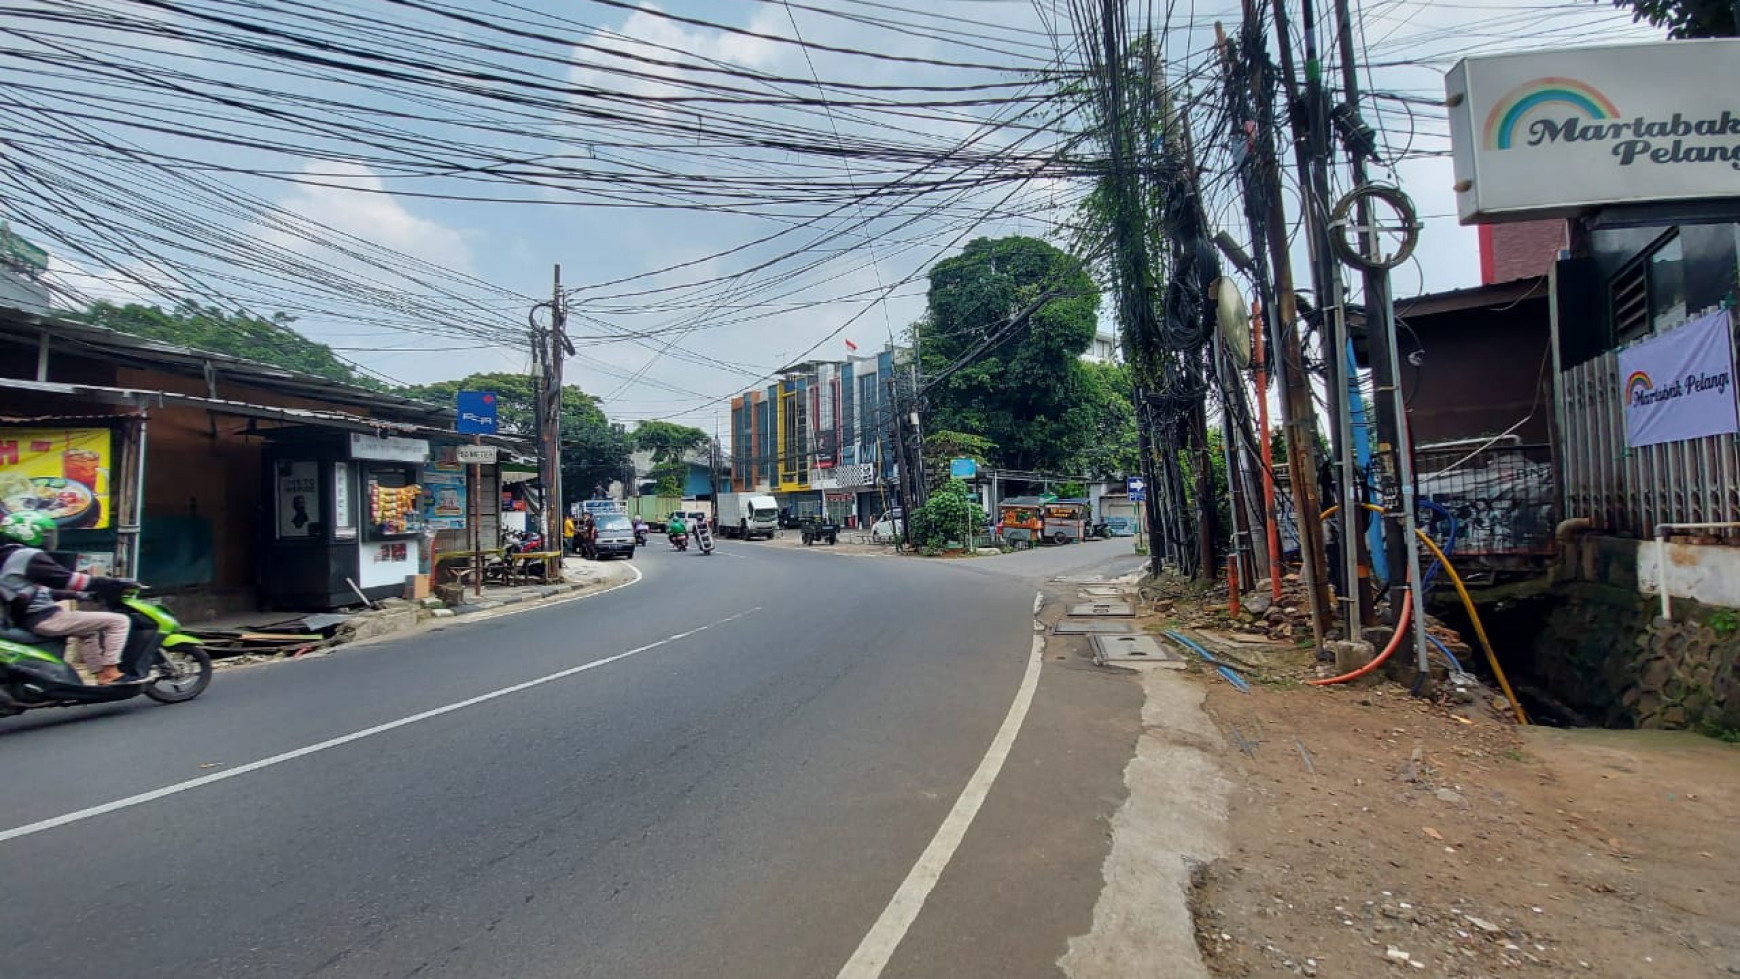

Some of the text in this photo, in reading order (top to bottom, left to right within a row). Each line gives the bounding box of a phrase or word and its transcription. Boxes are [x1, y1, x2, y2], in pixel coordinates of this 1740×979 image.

[1527, 111, 1740, 146] Martabak
[1633, 366, 1729, 408] Martabak Pelangi
